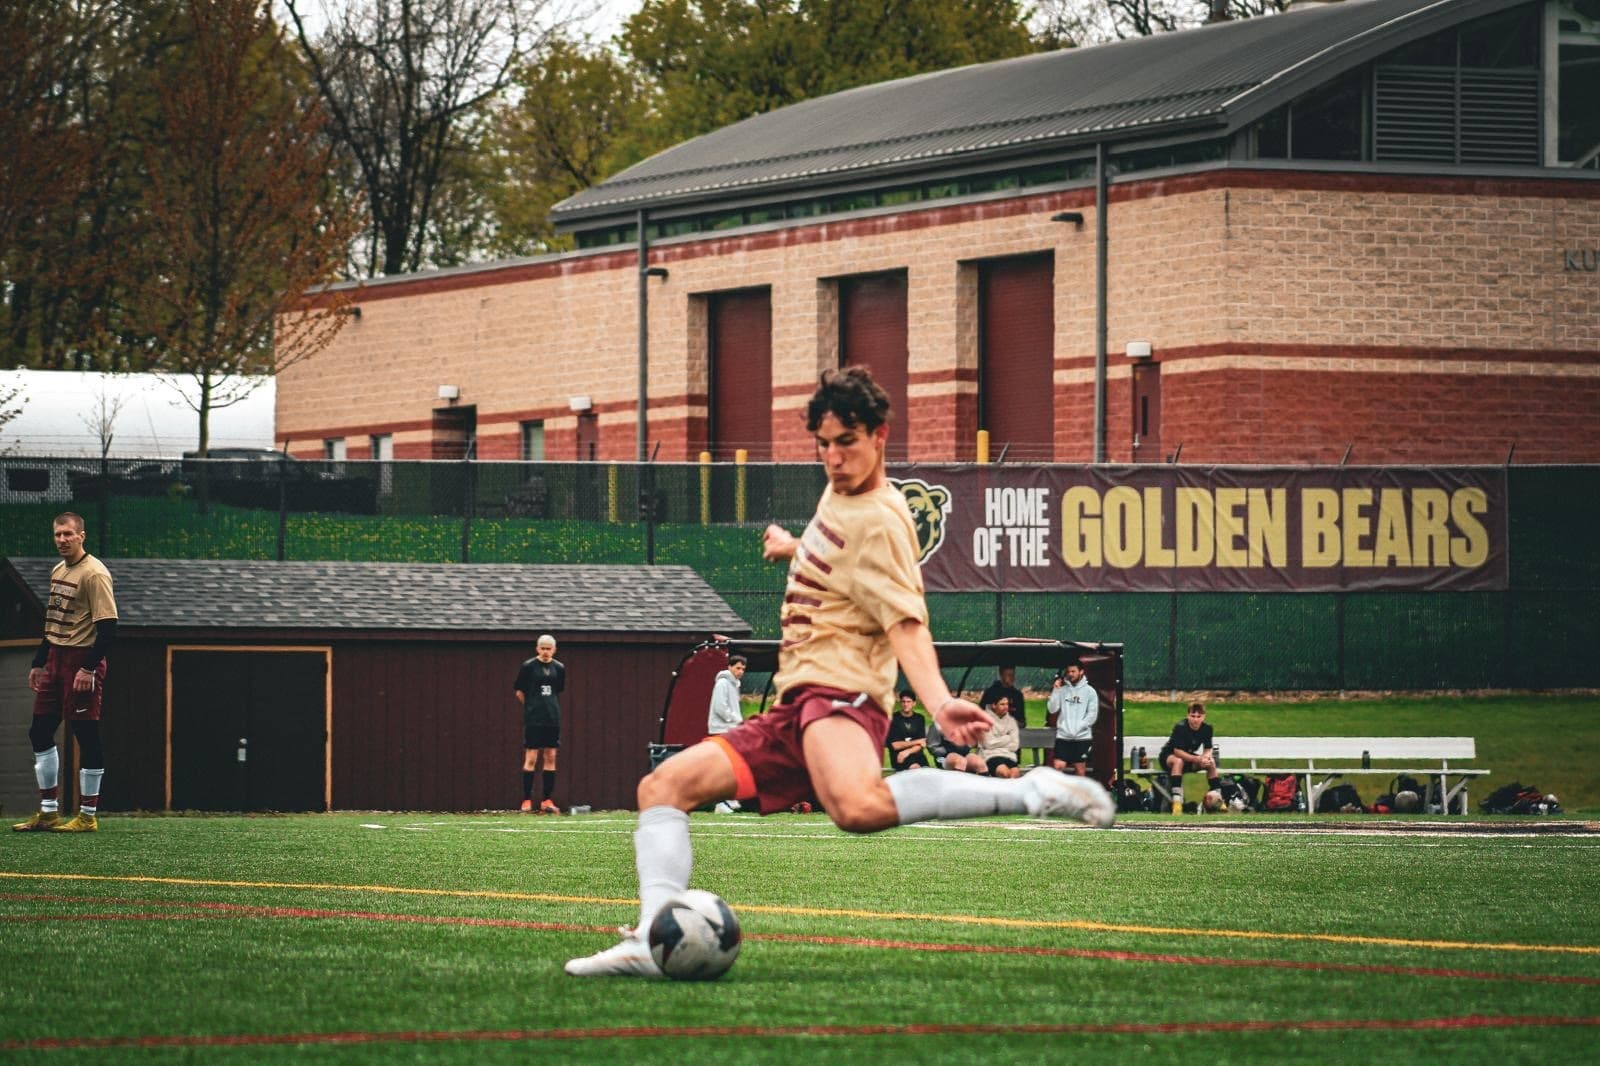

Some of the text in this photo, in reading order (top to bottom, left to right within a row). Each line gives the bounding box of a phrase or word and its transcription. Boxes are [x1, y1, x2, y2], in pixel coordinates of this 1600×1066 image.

[985, 487, 1050, 526] HOME
[973, 527, 1050, 567] OF THE
[1061, 485, 1489, 569] GOLDEN BEARS
